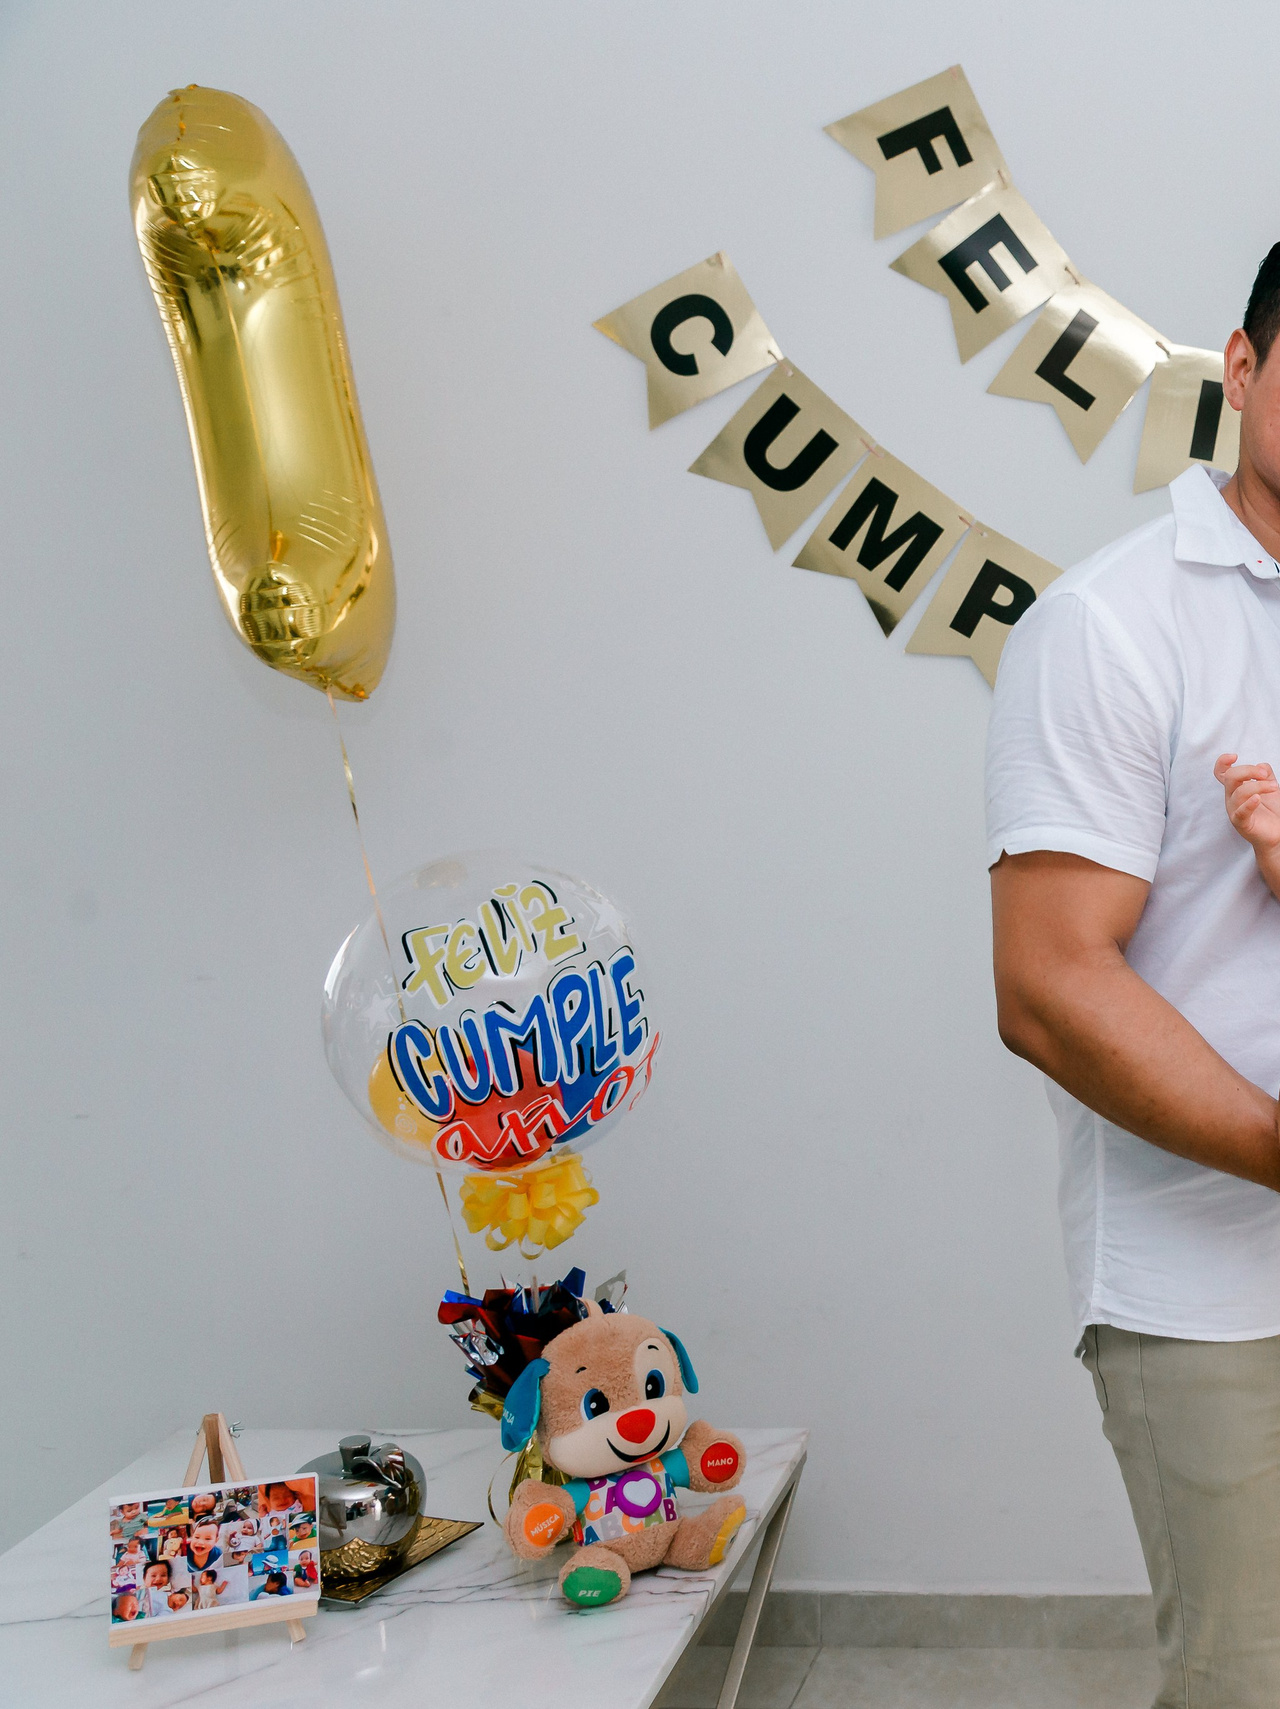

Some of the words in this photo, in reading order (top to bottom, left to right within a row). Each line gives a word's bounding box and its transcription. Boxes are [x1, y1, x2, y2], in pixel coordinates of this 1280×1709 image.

[650, 293, 1037, 639] CUMP
[389, 947, 646, 1123] CUMPLE
[707, 1457, 734, 1468] MANO
[530, 1513, 560, 1537] MÚSICA
[578, 1590, 601, 1598] PIE
